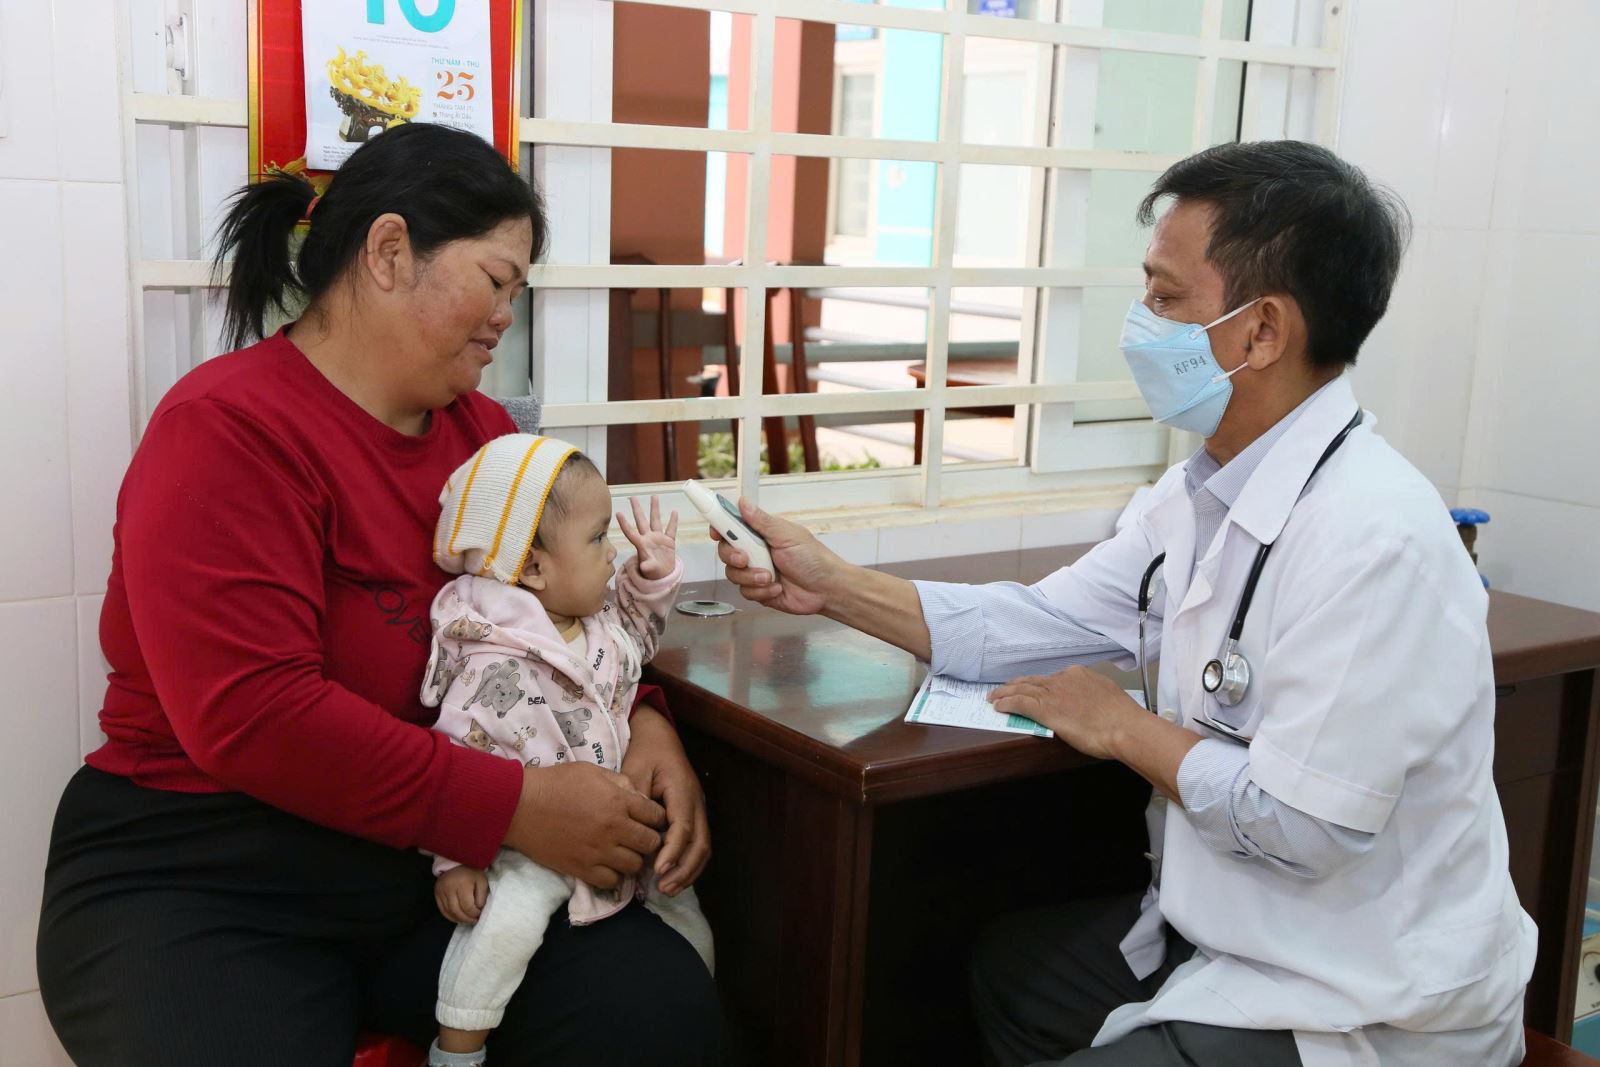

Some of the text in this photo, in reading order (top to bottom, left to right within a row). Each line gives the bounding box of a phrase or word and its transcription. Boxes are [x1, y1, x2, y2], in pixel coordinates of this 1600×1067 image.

[436, 70, 475, 101] 25
[1174, 355, 1207, 375] KF94
[593, 648, 605, 671] BEAR
[527, 696, 547, 705] BEA
[592, 742, 605, 765] BEAR
